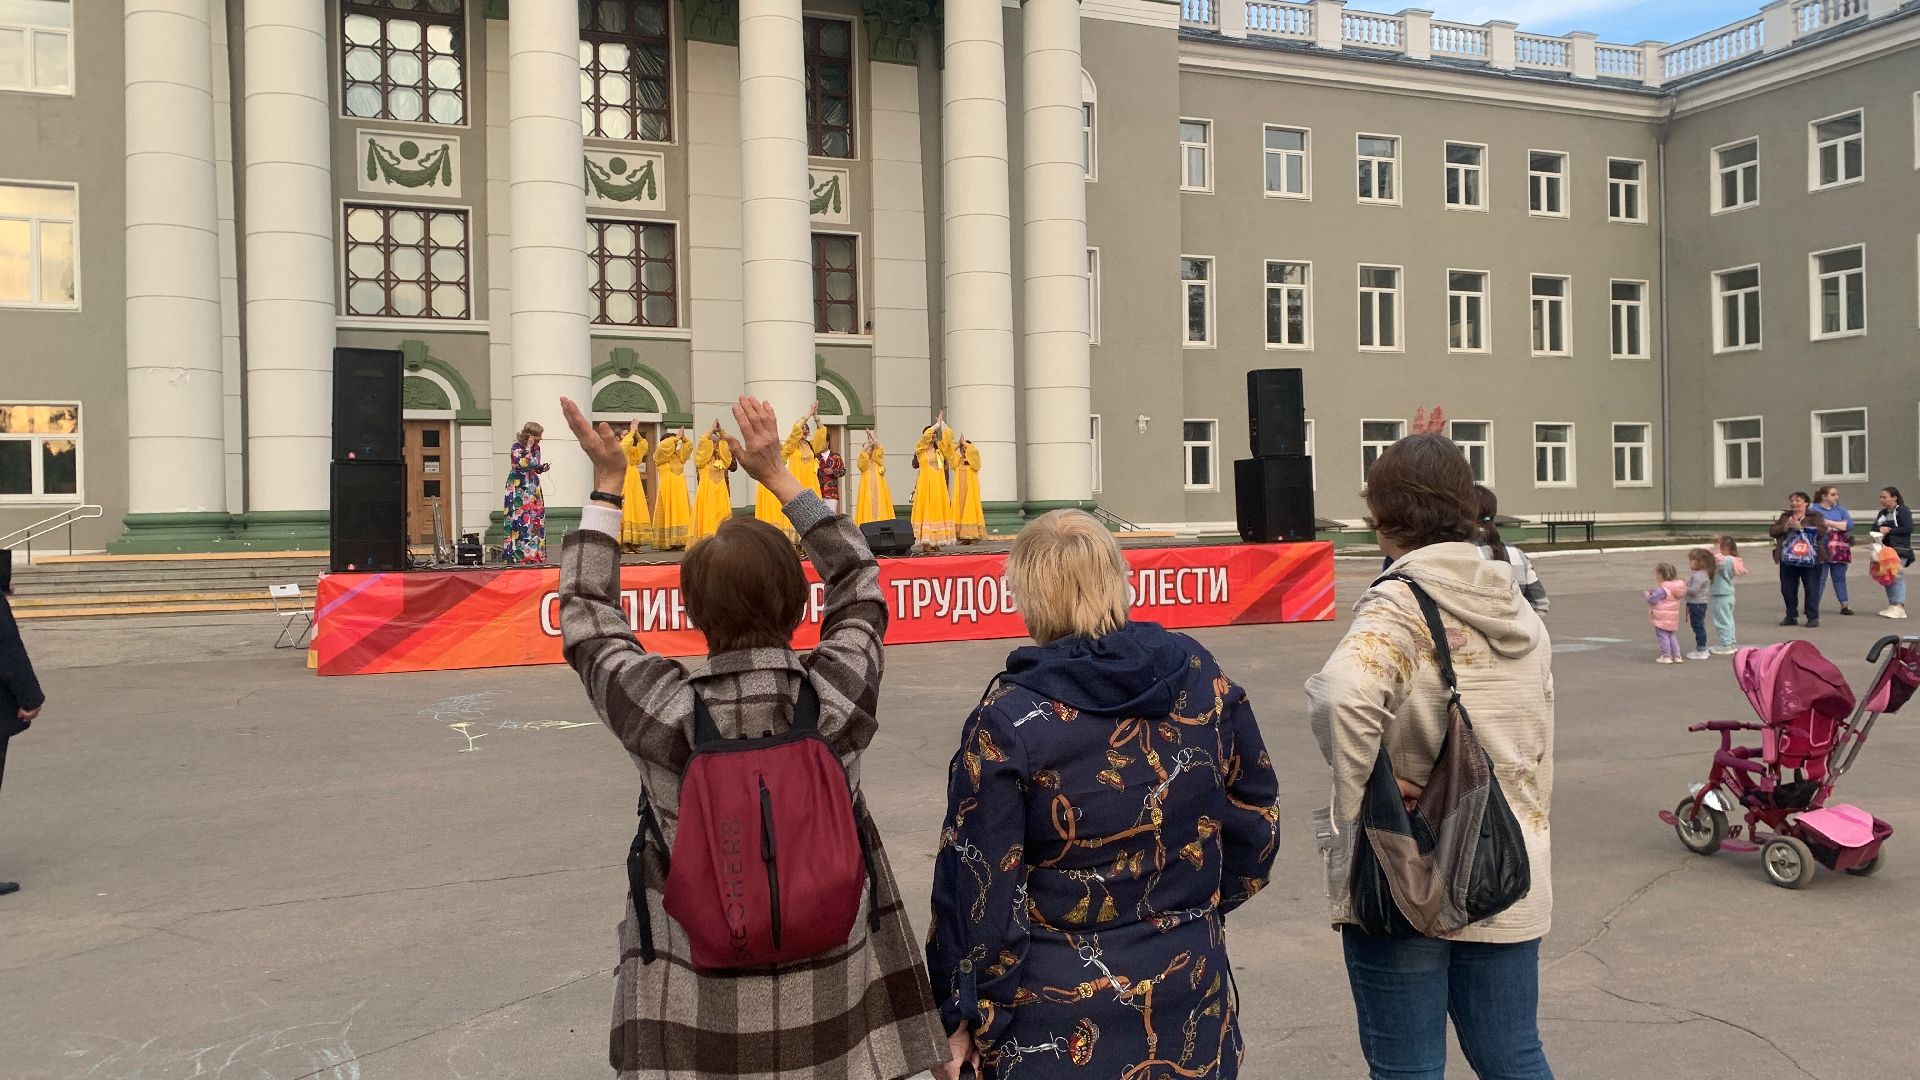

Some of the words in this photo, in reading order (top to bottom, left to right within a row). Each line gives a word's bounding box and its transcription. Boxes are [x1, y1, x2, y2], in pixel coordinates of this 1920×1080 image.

[540, 588, 694, 636] СПИН
[890, 576, 1018, 623] ТРУДОВ
[1126, 567, 1229, 606] ЛЕСТИ
